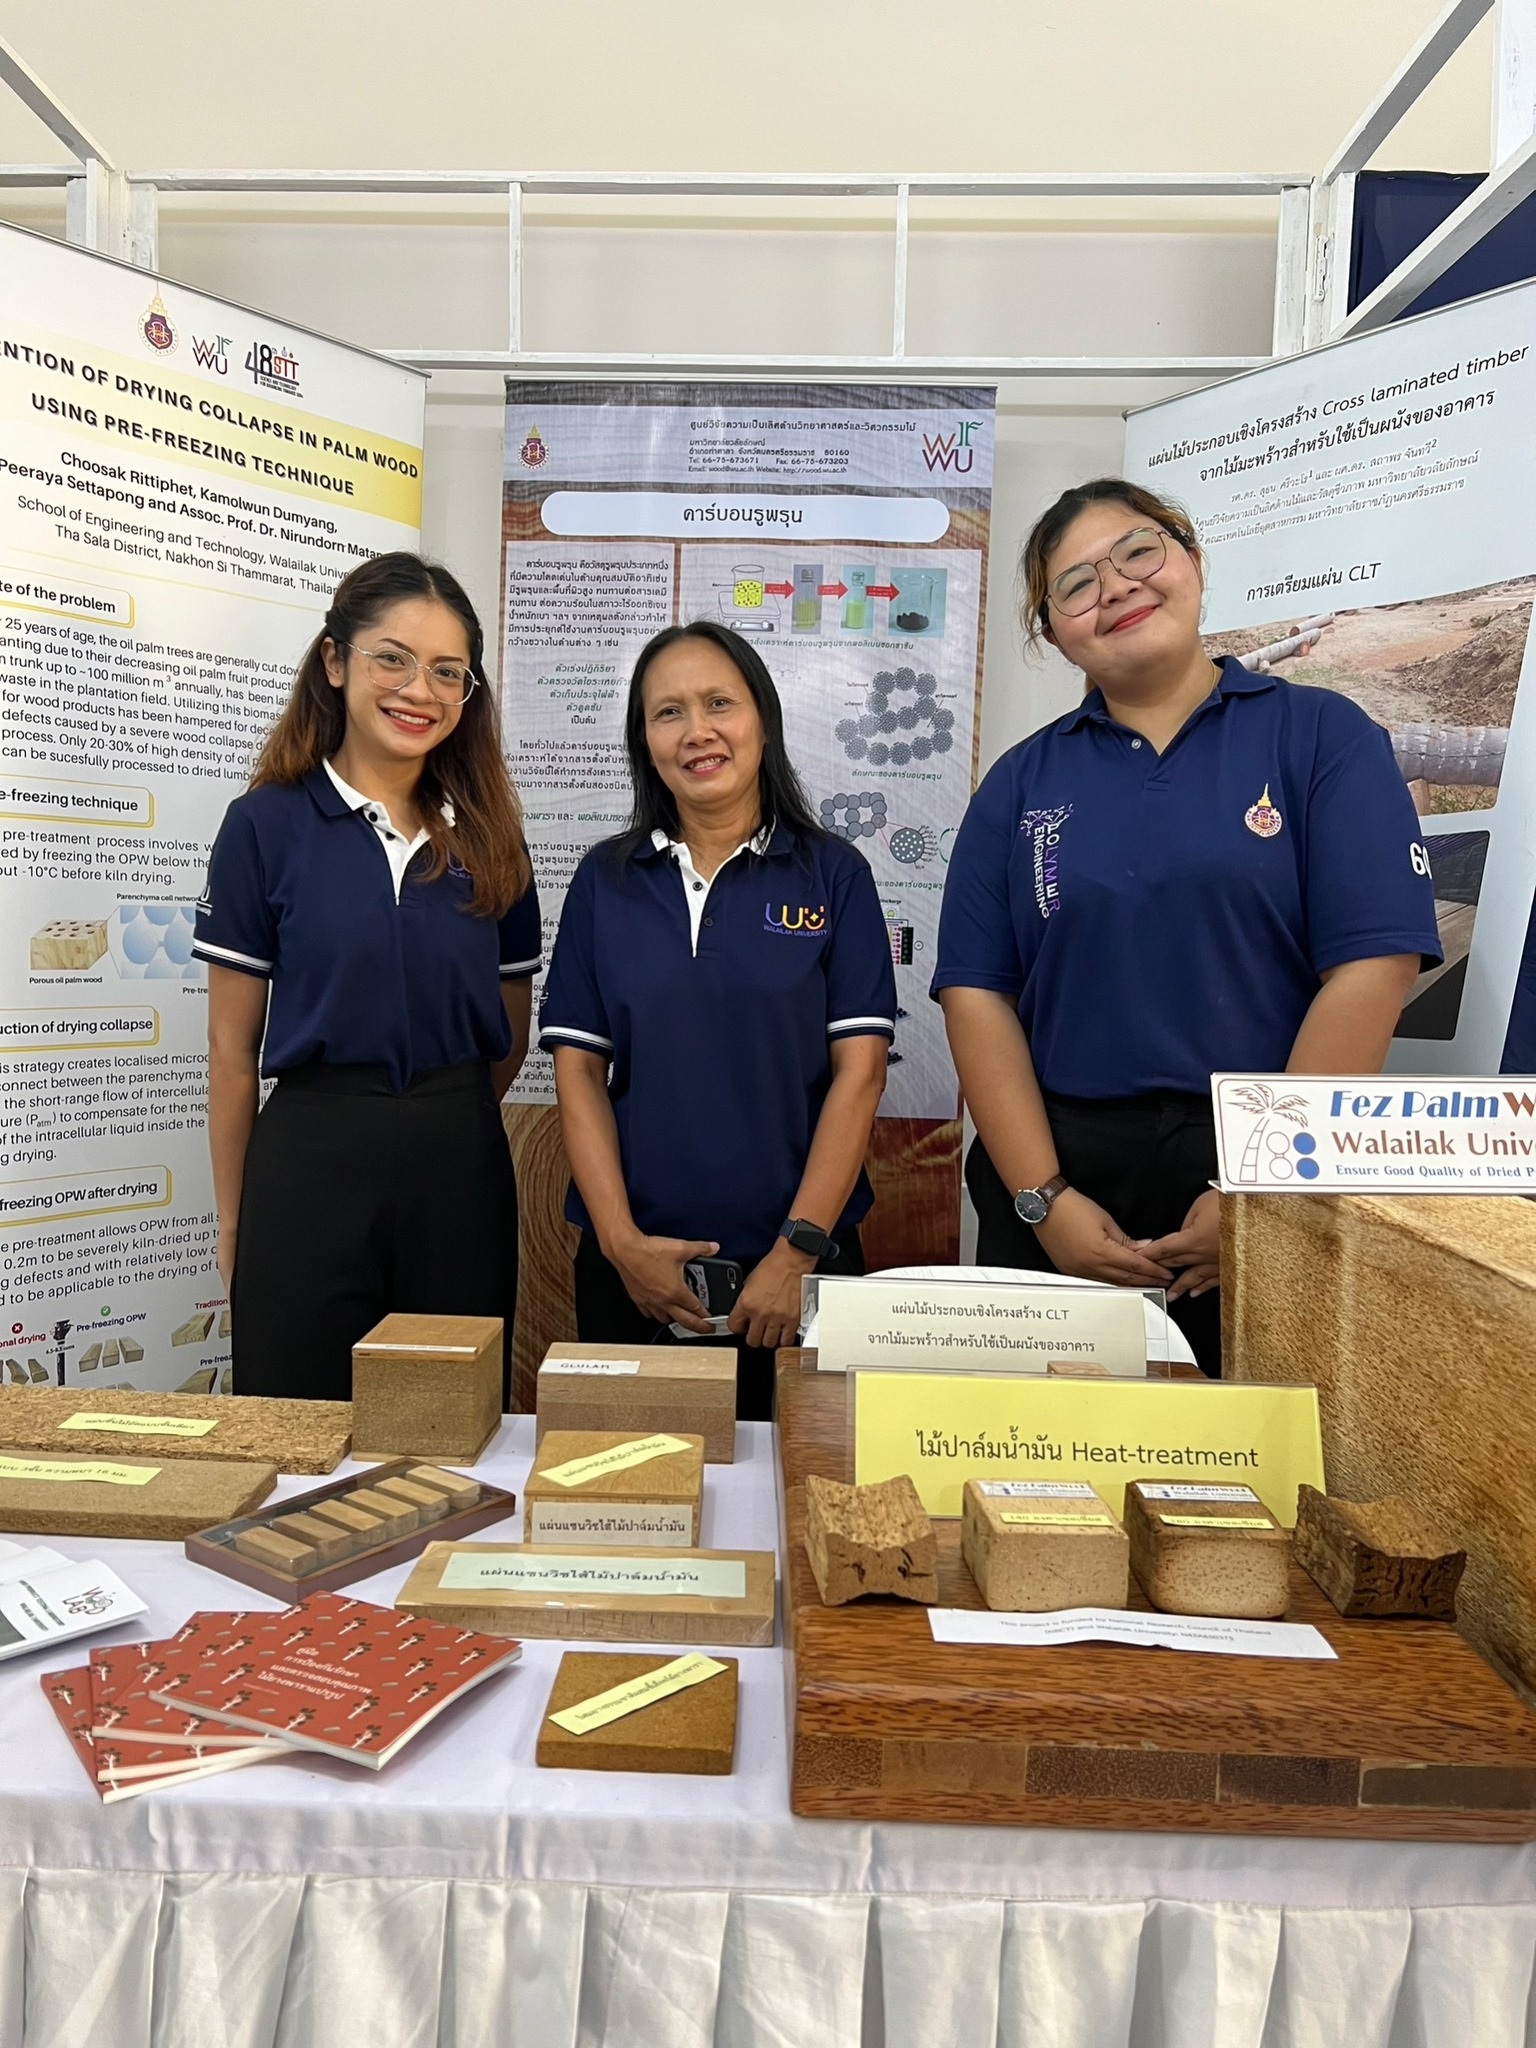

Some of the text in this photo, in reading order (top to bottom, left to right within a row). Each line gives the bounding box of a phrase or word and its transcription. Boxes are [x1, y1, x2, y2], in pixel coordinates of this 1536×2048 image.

[0, 339, 418, 479] NTION OF DRYING COLLAPSE IN PALM WOOD
[1148, 344, 1530, 469] แผ่นไม้ประกอบเชิงโครงสร้าง Cross laminated timber
[31, 391, 354, 497] USING PRE-FREEZING TECHNIQUE
[1199, 388, 1497, 483] จากไม้มะพร้าวสำหรับใช้เป็นผนังของอาคาร
[60, 450, 338, 535] Choosak Rittiphet, Kamolwun Dumyang,
[66, 474, 345, 554] Settapong Nirundorn
[683, 502, 803, 529] คาร์บอนรูพรุน
[85, 510, 317, 575] Engineering Technology, Walailak
[113, 537, 296, 590] District, Thammarat,
[1246, 561, 1382, 603] การเตรียมแผ่น CLT
[33, 585, 116, 614] the problem
[23, 621, 261, 673] years generally
[114, 653, 181, 682] decreasing
[77, 682, 138, 703] plantation
[111, 670, 224, 699] million annually,
[1, 707, 170, 741] defects severe
[174, 712, 232, 740] hampered
[1, 727, 134, 754] process. 20-30%
[49, 751, 110, 771] sucesfully
[71, 793, 139, 813] technique
[2, 829, 199, 853] pre-treatment involves
[42, 846, 92, 866] freezing
[1043, 822, 1062, 913] POLYMER
[61, 866, 176, 887] before drying.
[1032, 824, 1051, 920] ENGINEERING
[763, 923, 829, 938] WALAILAK UNIVERSITY
[56, 1018, 153, 1036] drying collapse
[114, 1052, 168, 1068] localised
[50, 1069, 203, 1091] between parenchyma
[29, 1093, 100, 1114] short-range
[73, 1105, 148, 1124] compensate
[1329, 1090, 1392, 1118] Fez
[35, 1124, 107, 1144] intracellular
[1331, 1129, 1456, 1156] Walailak
[12, 1147, 57, 1165] drying.
[1336, 1164, 1522, 1178] Ensure Good Quality of Dried
[54, 1179, 159, 1205] OPW after drying
[12, 1227, 96, 1255] pre-treatment
[132, 1230, 191, 1250] kiln-dried
[125, 1248, 183, 1274] relatively
[47, 1275, 115, 1300] applicable
[76, 1311, 147, 1333] Pre-freezing OPW
[892, 1301, 1070, 1321] แผ่นไม้ประกอบเชิงโครงสร้าง CLT
[17, 1332, 47, 1346] drying
[867, 1330, 1096, 1353] จากไม้มะพร้าวสำหรับใช้เป็นผนังของอาคาร
[916, 1425, 1260, 1469] ไม้ปาล์มน้ำมัน Heat-treatment
